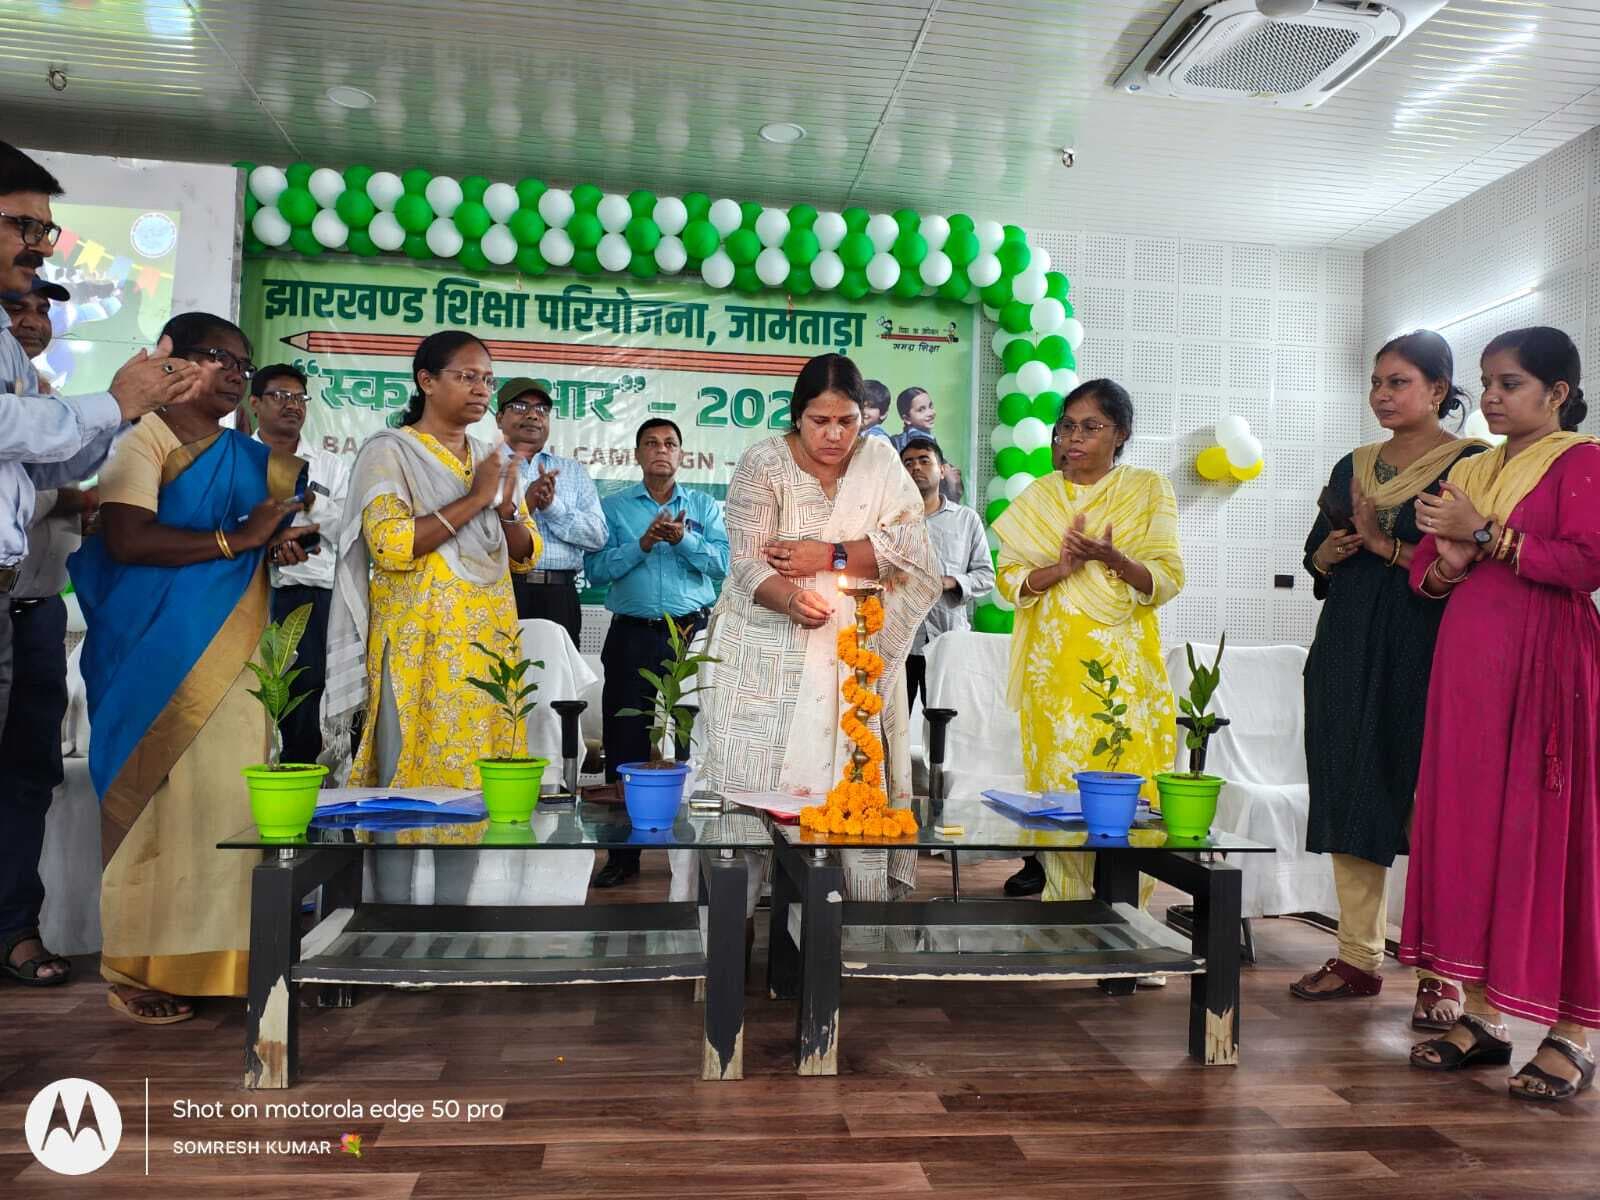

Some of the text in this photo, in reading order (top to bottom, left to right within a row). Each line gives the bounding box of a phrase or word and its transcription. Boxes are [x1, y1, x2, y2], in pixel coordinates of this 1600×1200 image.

[262, 277, 867, 355] झारखण्ड शिक्षा परियोजना, जामताड़ा
[696, 386, 795, 430] 202
[322, 435, 358, 455] BA
[573, 446, 714, 470] CAMGN
